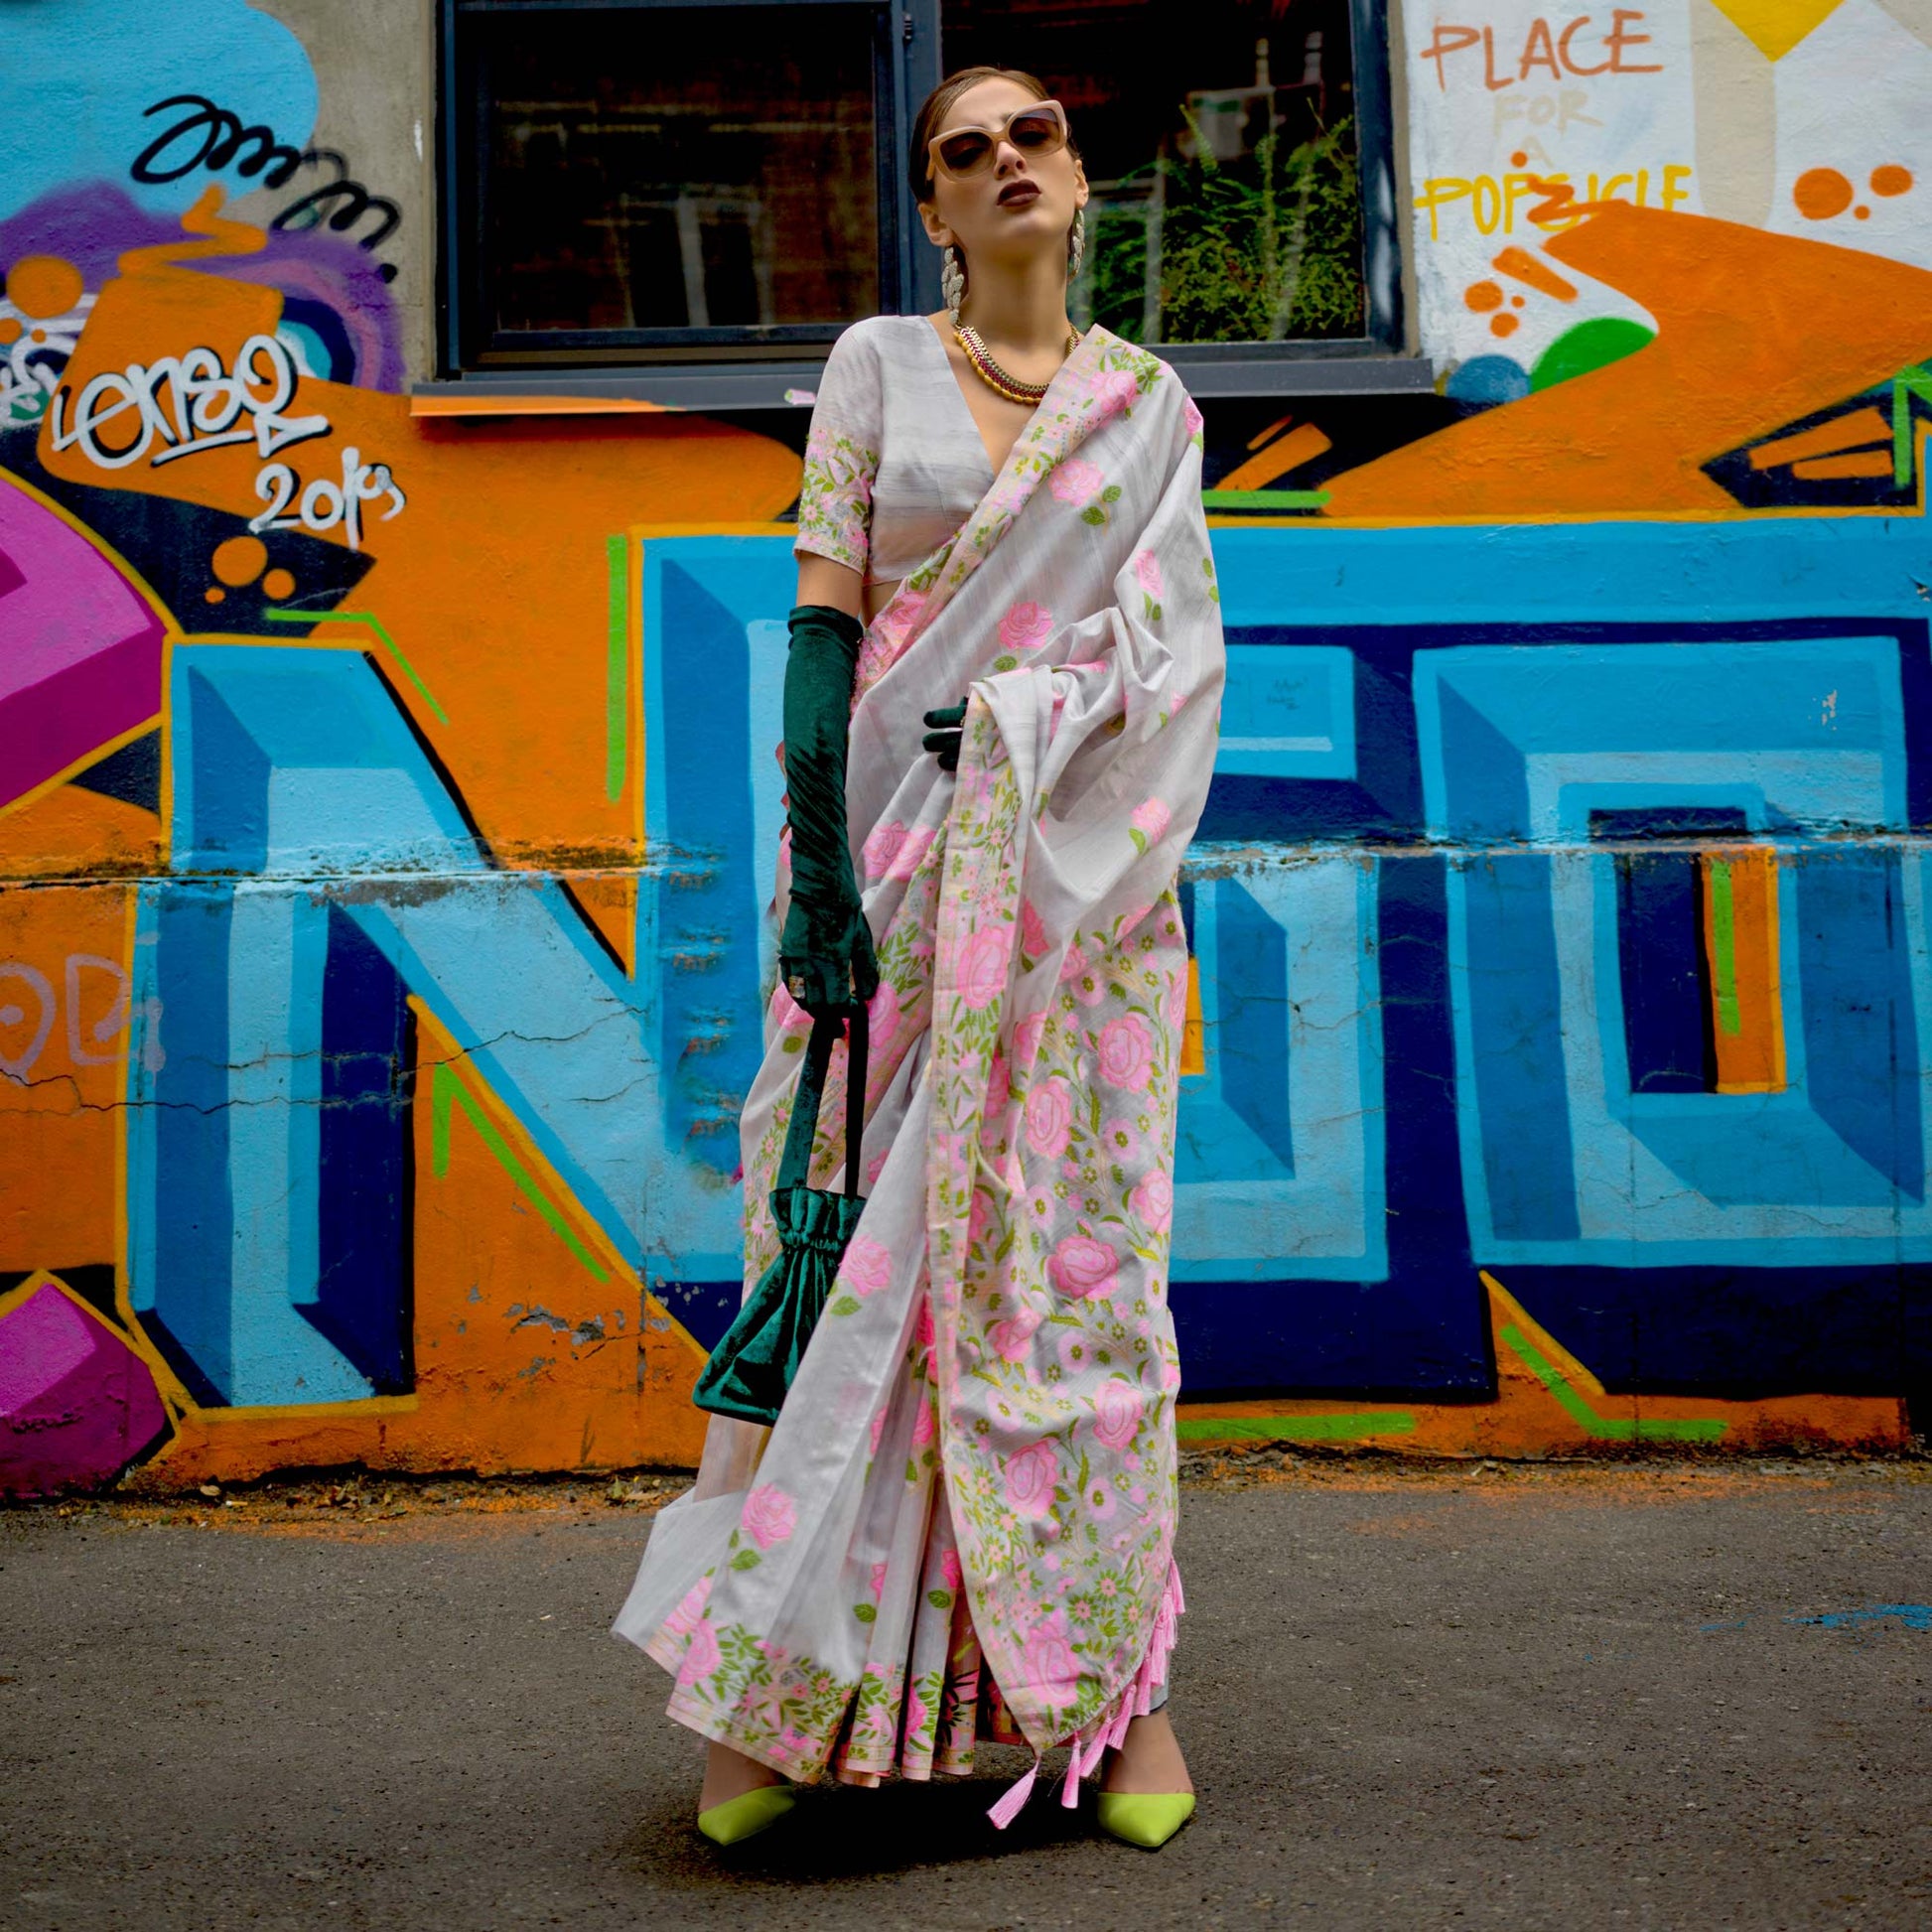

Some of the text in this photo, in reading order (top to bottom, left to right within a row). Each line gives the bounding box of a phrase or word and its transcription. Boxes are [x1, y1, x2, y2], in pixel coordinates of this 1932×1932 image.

[1419, 9, 1664, 92] PLACE
[1493, 89, 1604, 139] FOR
[1510, 135, 1555, 169] A
